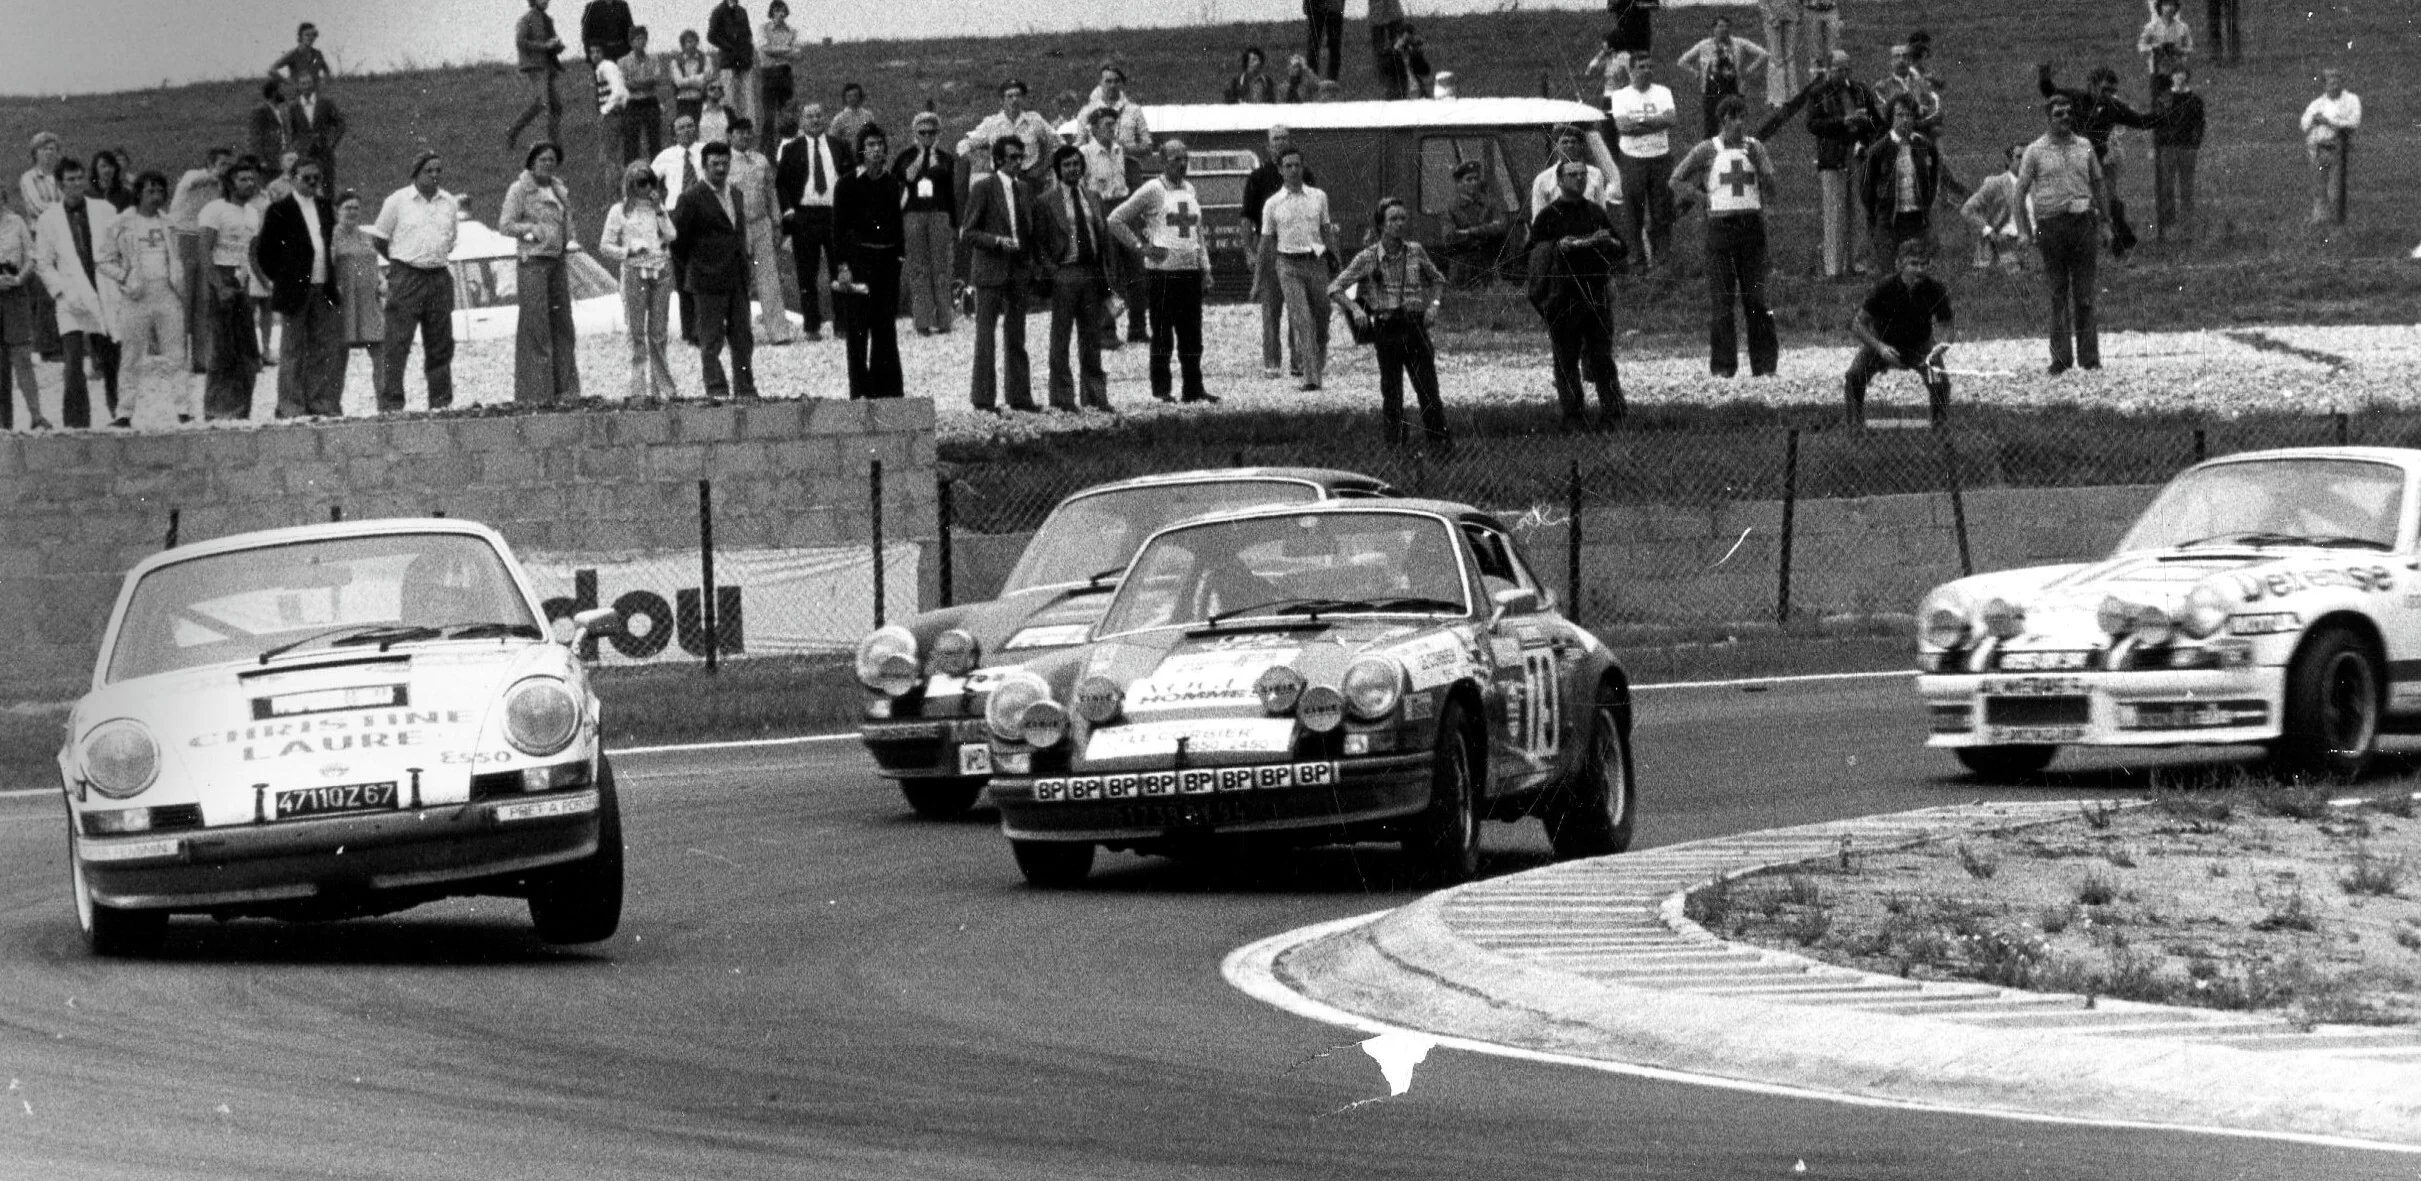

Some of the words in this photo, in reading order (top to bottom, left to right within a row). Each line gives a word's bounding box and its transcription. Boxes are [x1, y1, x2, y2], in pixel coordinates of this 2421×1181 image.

[187, 709, 473, 748] CHRISTINE
[242, 730, 424, 762] LAURE
[1038, 781, 1063, 799] BP
[1072, 779, 1098, 798] BP
[1110, 777, 1135, 797] BP
[1149, 775, 1174, 794] BP
[1184, 773, 1210, 792] BP
[1222, 770, 1249, 789] BP
[1260, 768, 1289, 787] BP
[1301, 764, 1328, 783] BP
